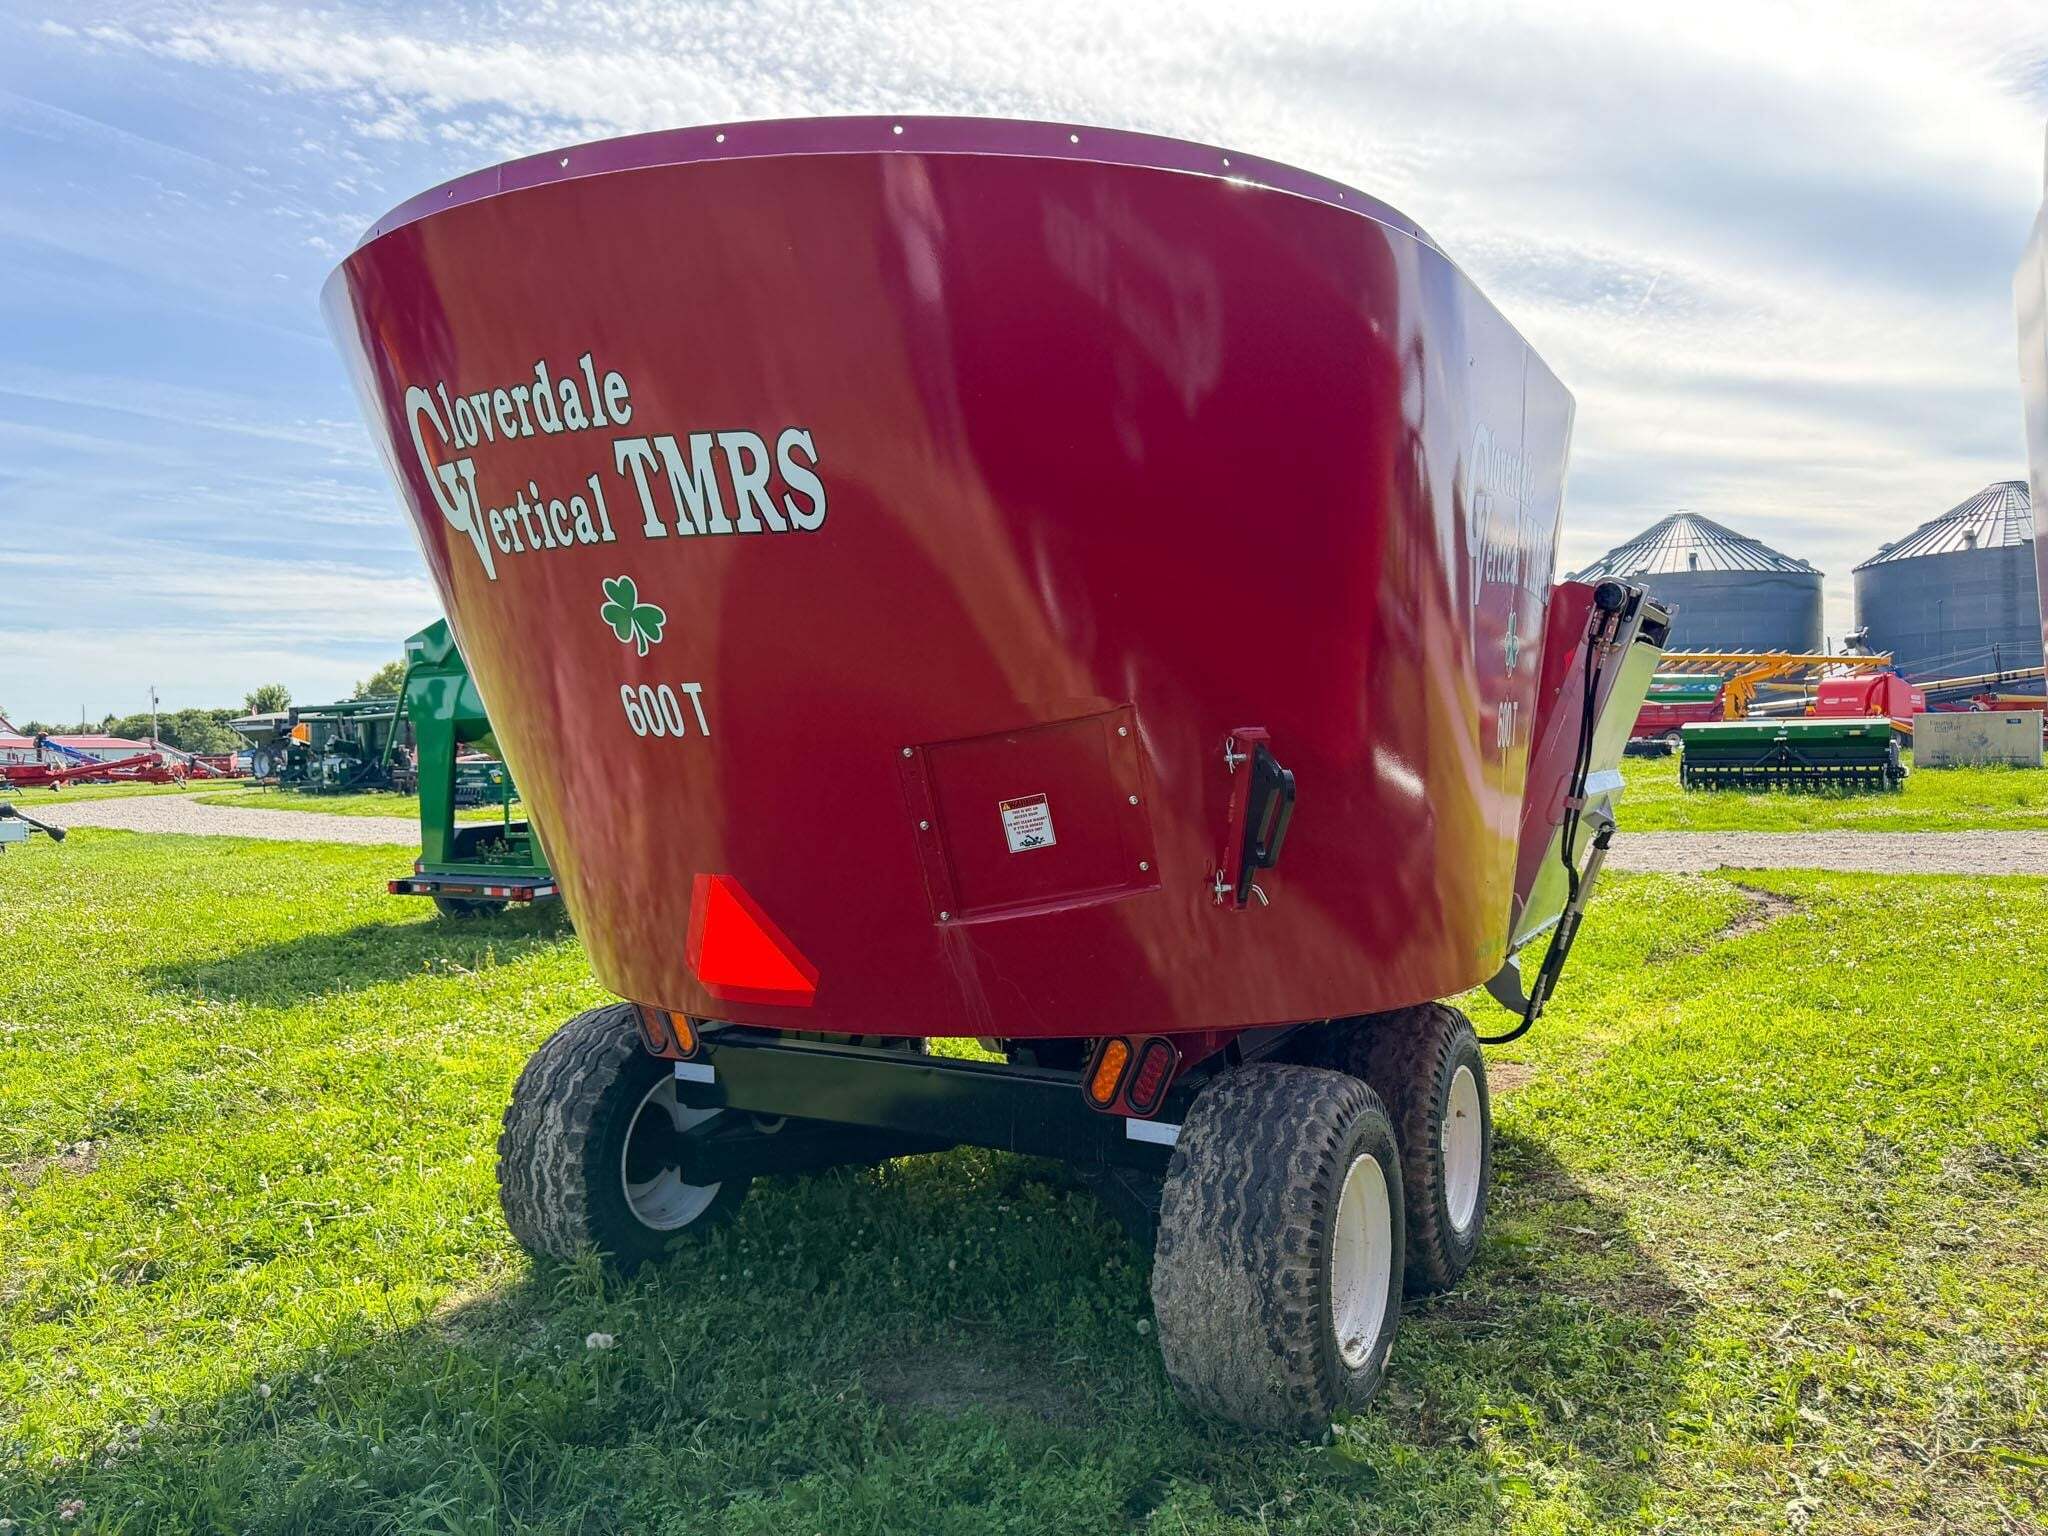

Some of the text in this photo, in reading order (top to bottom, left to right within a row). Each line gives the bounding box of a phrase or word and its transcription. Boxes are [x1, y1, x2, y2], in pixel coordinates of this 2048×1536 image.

[405, 353, 632, 532] Cloverdale
[437, 428, 826, 581] Vertical TMRS
[620, 682, 711, 737] 600 T
